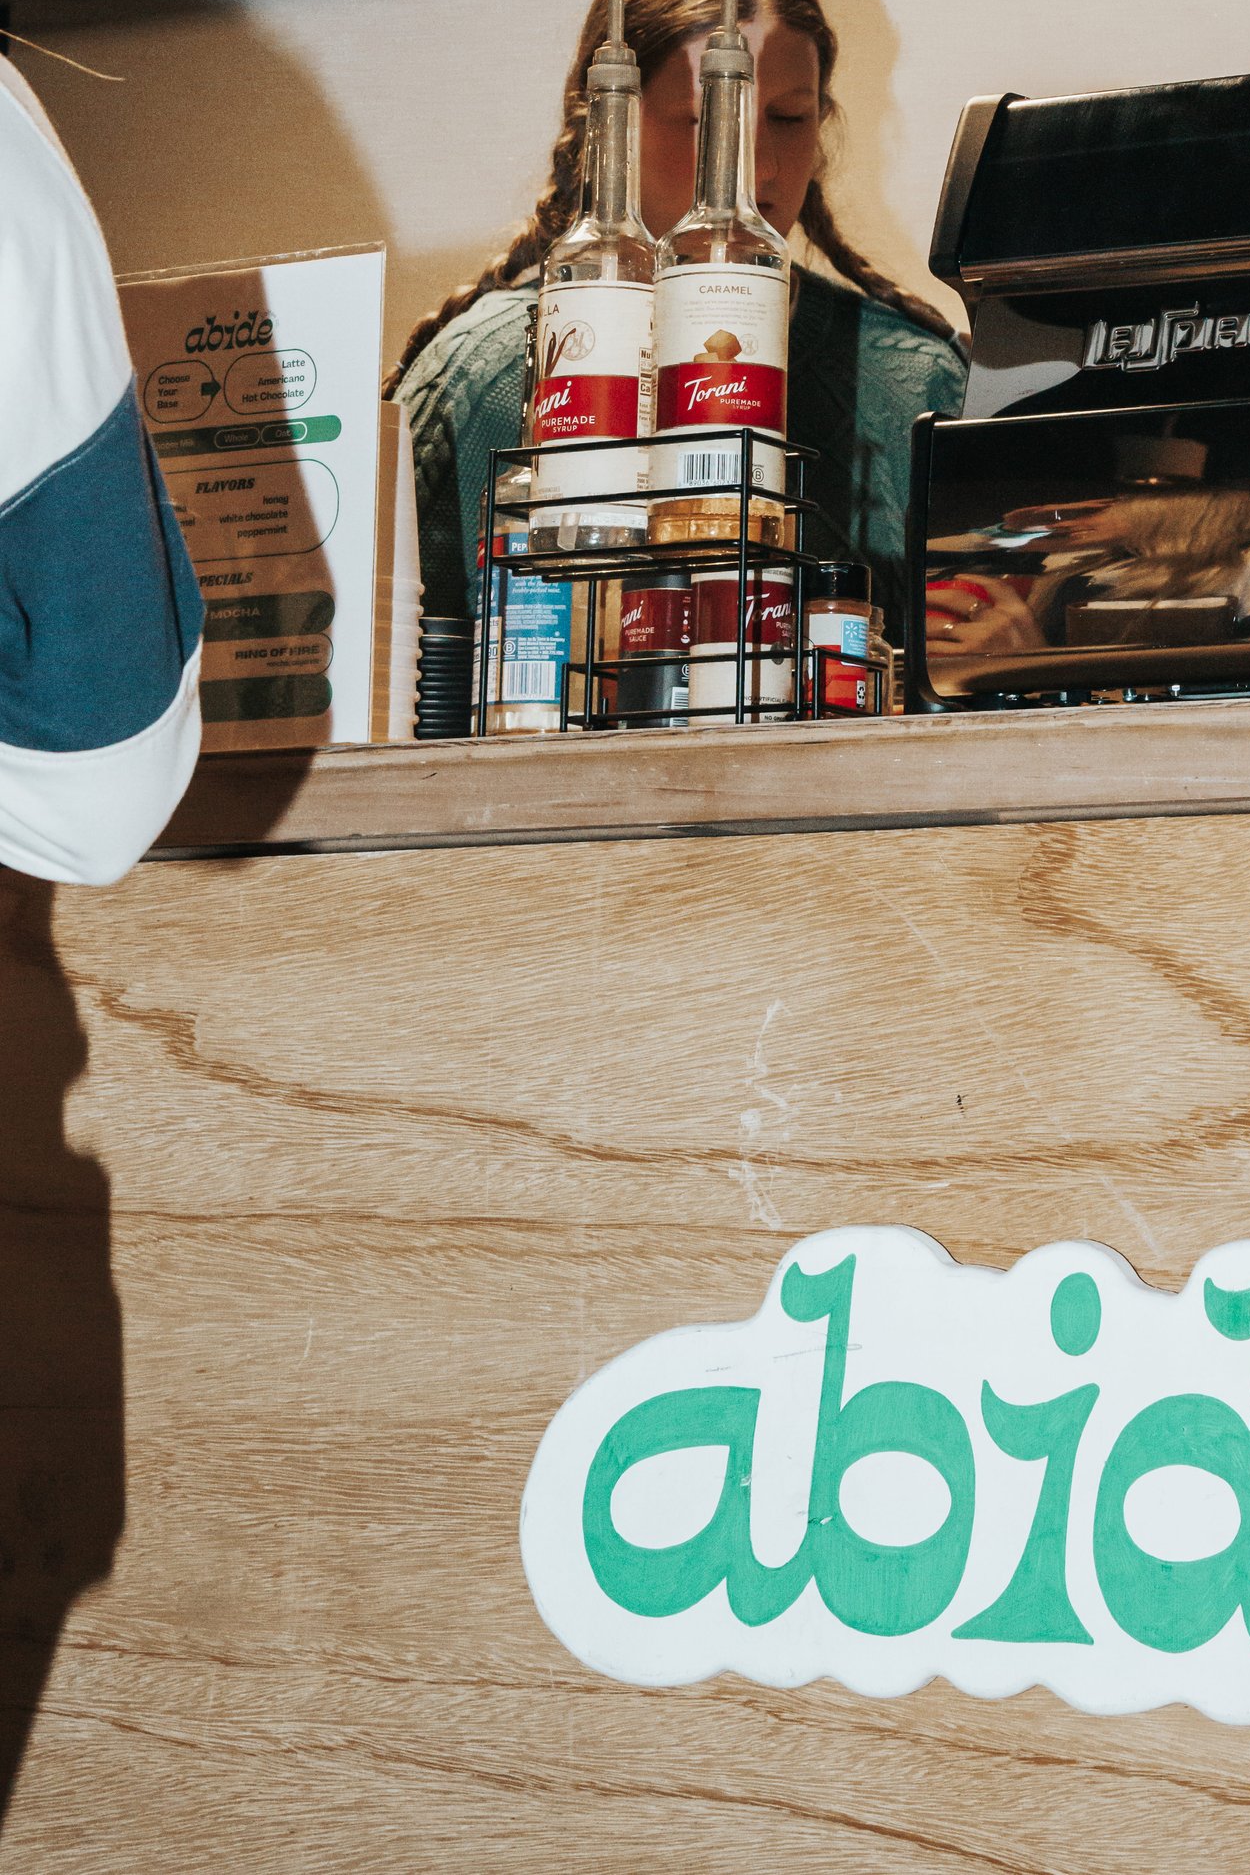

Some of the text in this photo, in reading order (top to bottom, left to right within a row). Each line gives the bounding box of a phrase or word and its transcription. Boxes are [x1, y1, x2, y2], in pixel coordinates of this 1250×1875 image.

[699, 285, 752, 295] CARAMEL
[184, 310, 273, 354] abide
[282, 359, 306, 369] Latte
[158, 375, 190, 385] Choose
[258, 375, 305, 387] Americano
[157, 388, 178, 397] Your
[242, 389, 305, 403] Hot Chocolate
[684, 376, 748, 411] Torani
[157, 400, 178, 409] Base
[534, 380, 572, 420] rani
[720, 398, 761, 407] PUREMADE
[541, 415, 596, 428] PUREMADE
[552, 425, 578, 434] SYRUP
[195, 478, 255, 494] FLAVORS
[263, 495, 289, 505] honey
[219, 509, 289, 524] white chocolate
[237, 525, 288, 539] peppermint
[197, 572, 253, 587] PECIALS
[210, 607, 261, 619] MOCHA
[235, 649, 267, 660] RING
[270, 647, 288, 657] OF
